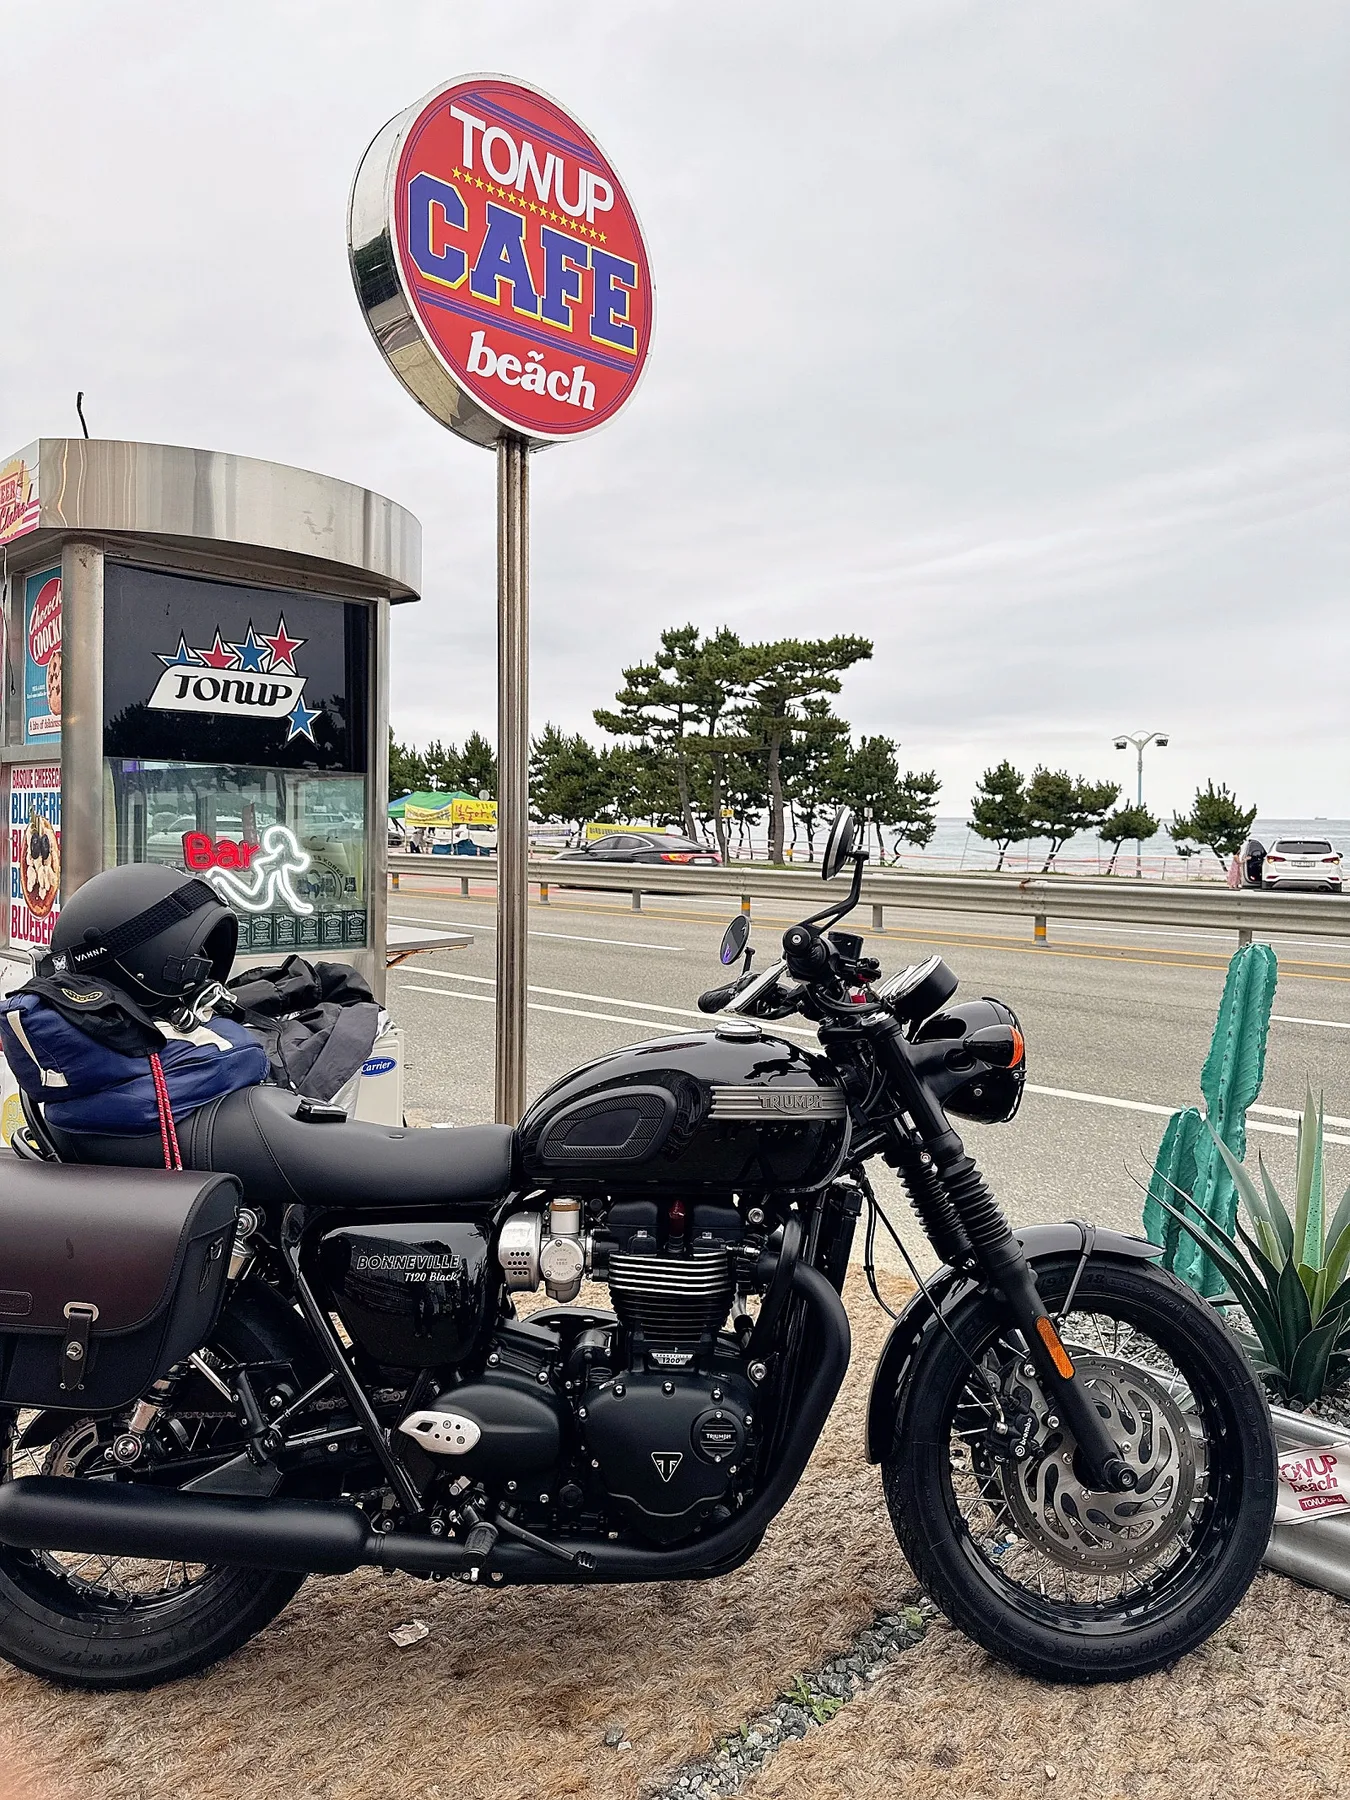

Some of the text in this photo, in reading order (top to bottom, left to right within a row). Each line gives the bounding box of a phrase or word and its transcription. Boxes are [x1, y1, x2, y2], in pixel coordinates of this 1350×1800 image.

[449, 104, 614, 224] TONUP
[408, 171, 639, 355] CAFE
[174, 674, 293, 706] TONUP
[184, 832, 260, 869] Bar
[361, 1061, 392, 1072] Carrier
[760, 1094, 823, 1112] TRIUMPH
[356, 1254, 460, 1270] BONNEVILLE
[404, 1271, 458, 1282] T120 Black
[706, 1433, 732, 1441] TRIUMPH
[1019, 1417, 1033, 1446] brembo
